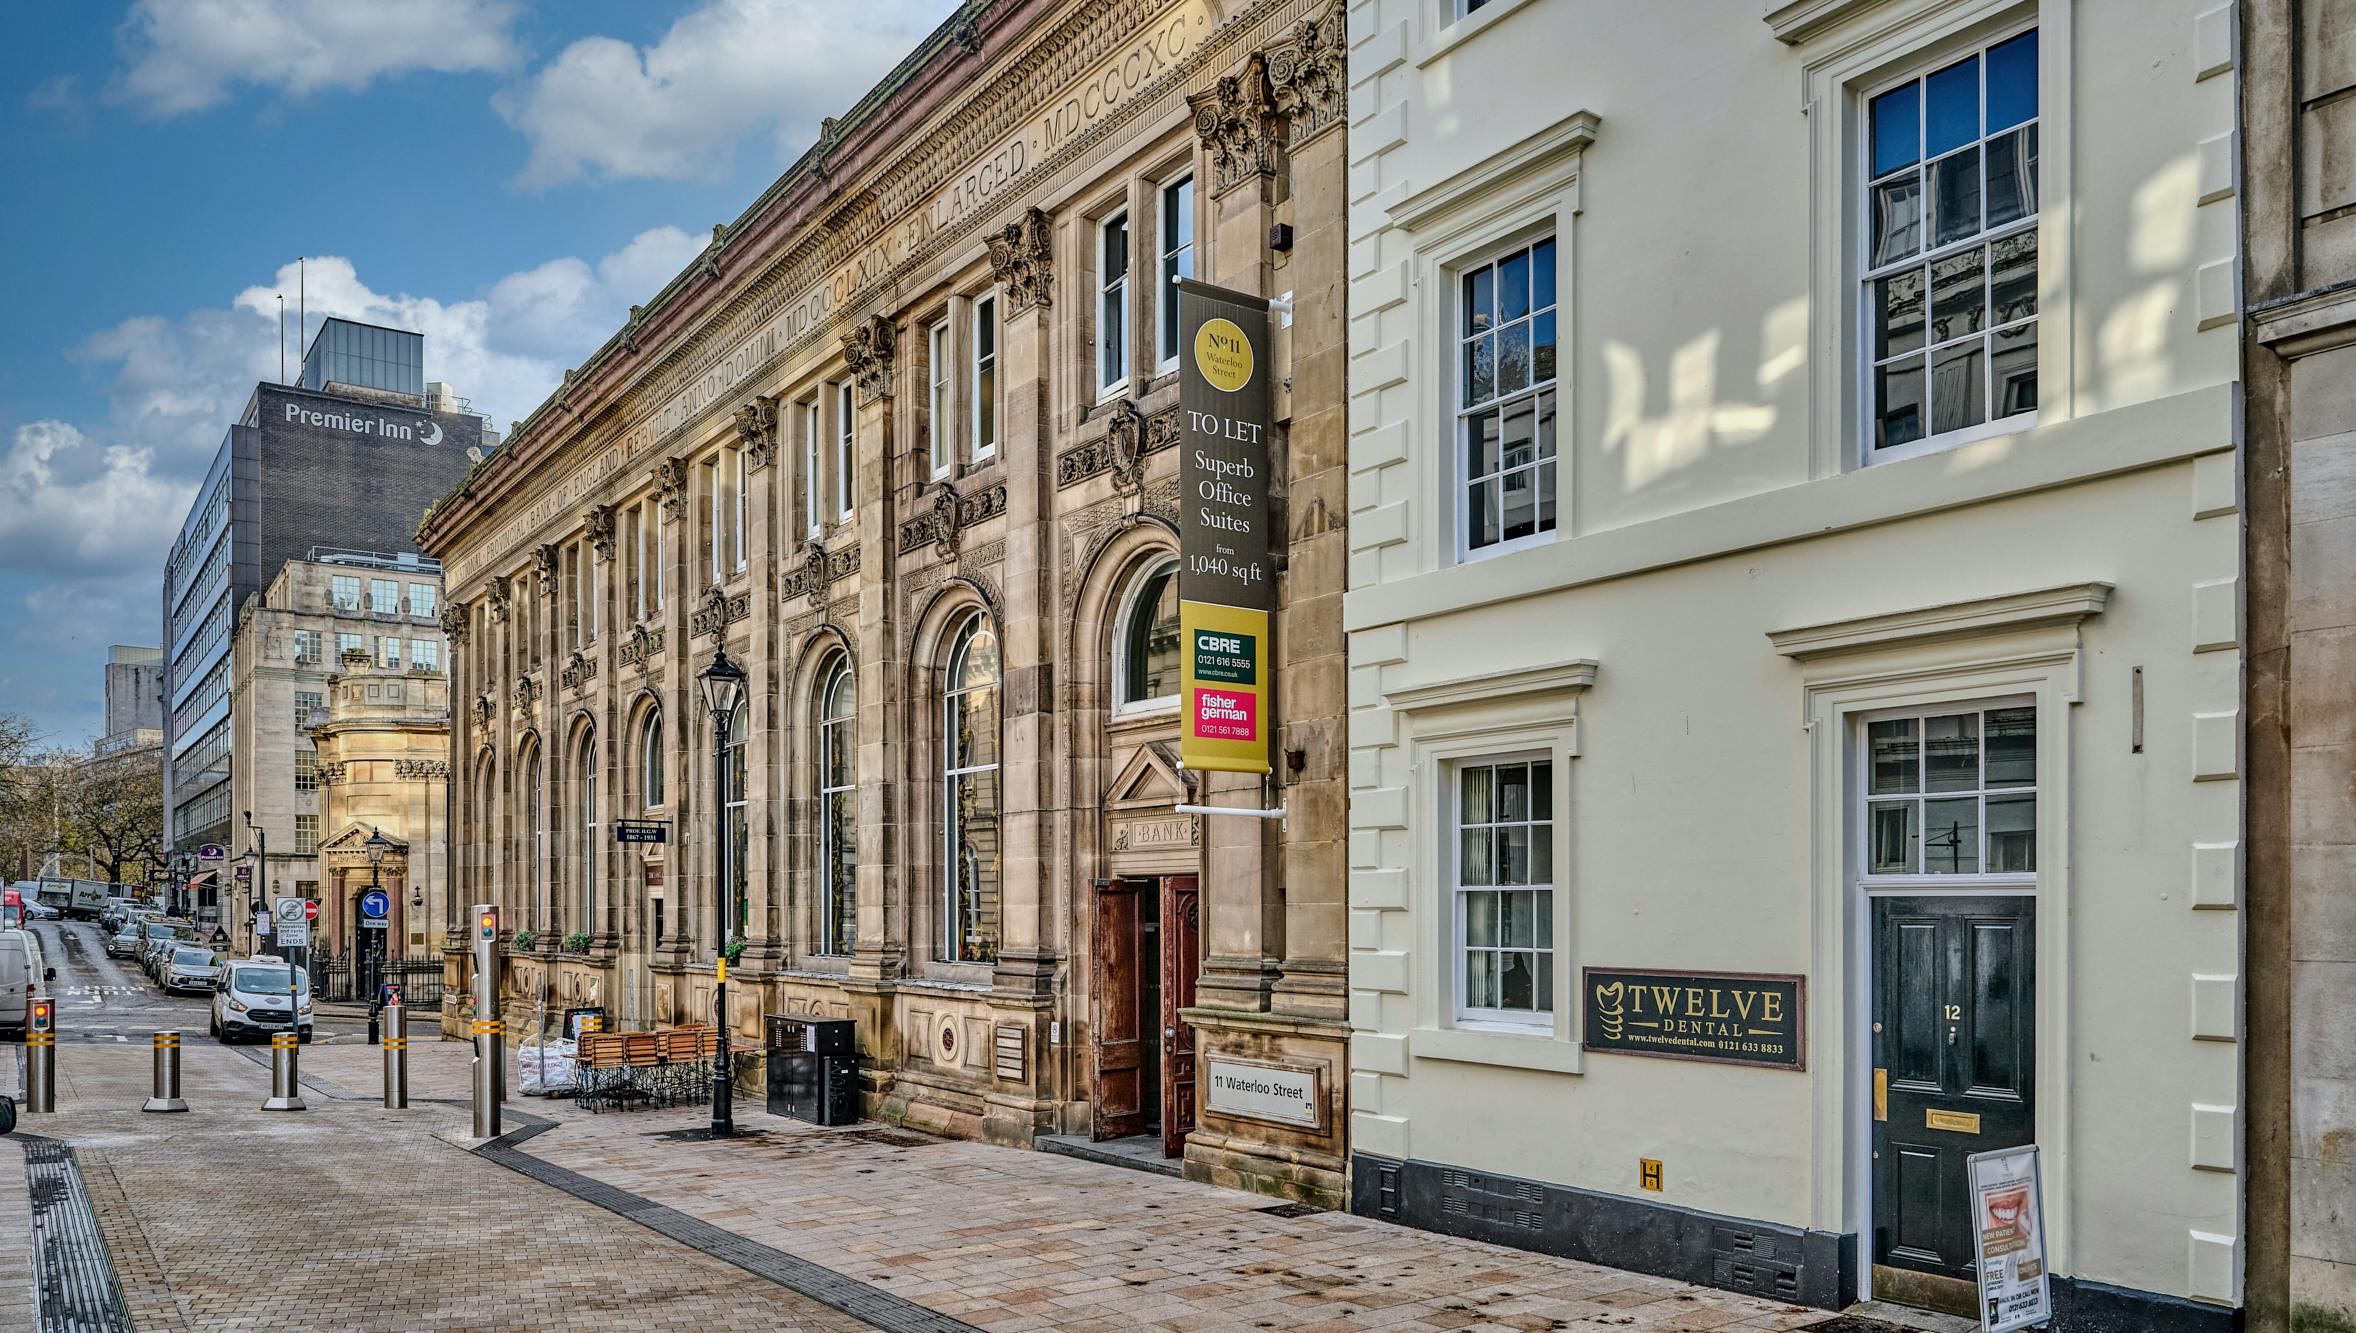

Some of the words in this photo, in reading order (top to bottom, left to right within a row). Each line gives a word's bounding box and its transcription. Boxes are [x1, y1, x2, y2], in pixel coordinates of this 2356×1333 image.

[454, 552, 482, 583] NATIONAL
[486, 520, 526, 561] PROVINCIAL
[530, 498, 551, 528] BANK
[557, 485, 567, 508] OF
[574, 448, 618, 497] ENGLAND
[680, 375, 715, 420] ANNO
[726, 328, 775, 386] DOMINI
[786, 236, 892, 341] MDCCCLXIX
[1043, 14, 1186, 151] MDCCCXC
[1206, 352, 1243, 369] Waterloo
[1212, 365, 1236, 378] Street
[285, 403, 375, 434] Premier
[379, 418, 412, 440] Inn
[1187, 410, 1218, 435] TO
[1224, 418, 1261, 444] LET
[1195, 450, 1254, 480] Superb
[1199, 480, 1251, 507] Office
[1200, 507, 1250, 533] Suites
[1216, 543, 1234, 555] from
[1189, 554, 1228, 575] 1,040
[1198, 635, 1241, 654] CBRE
[1198, 655, 1215, 665] 0121
[1216, 657, 1230, 667] 616
[1231, 658, 1251, 669] 5555
[1202, 693, 1236, 709] fisher
[1201, 707, 1247, 720] german
[1201, 725, 1217, 733] 0121
[1218, 726, 1230, 735] 561
[1232, 727, 1249, 736] 7888
[1142, 822, 1184, 842] BANK
[1628, 985, 1783, 1022] TWELVE
[1944, 1004, 1961, 1020] 12
[1664, 1019, 1743, 1037] DENTAL
[1628, 1034, 1716, 1048] www.twelvedental.com
[1718, 1038, 1740, 1051] 0121
[1742, 1042, 1758, 1052] 633
[1761, 1043, 1783, 1054] 8833
[1215, 1075, 1223, 1088] 11
[1226, 1076, 1270, 1095] Waterloo
[1273, 1083, 1303, 1099] Street
[1986, 1269, 2004, 1280] FREE
